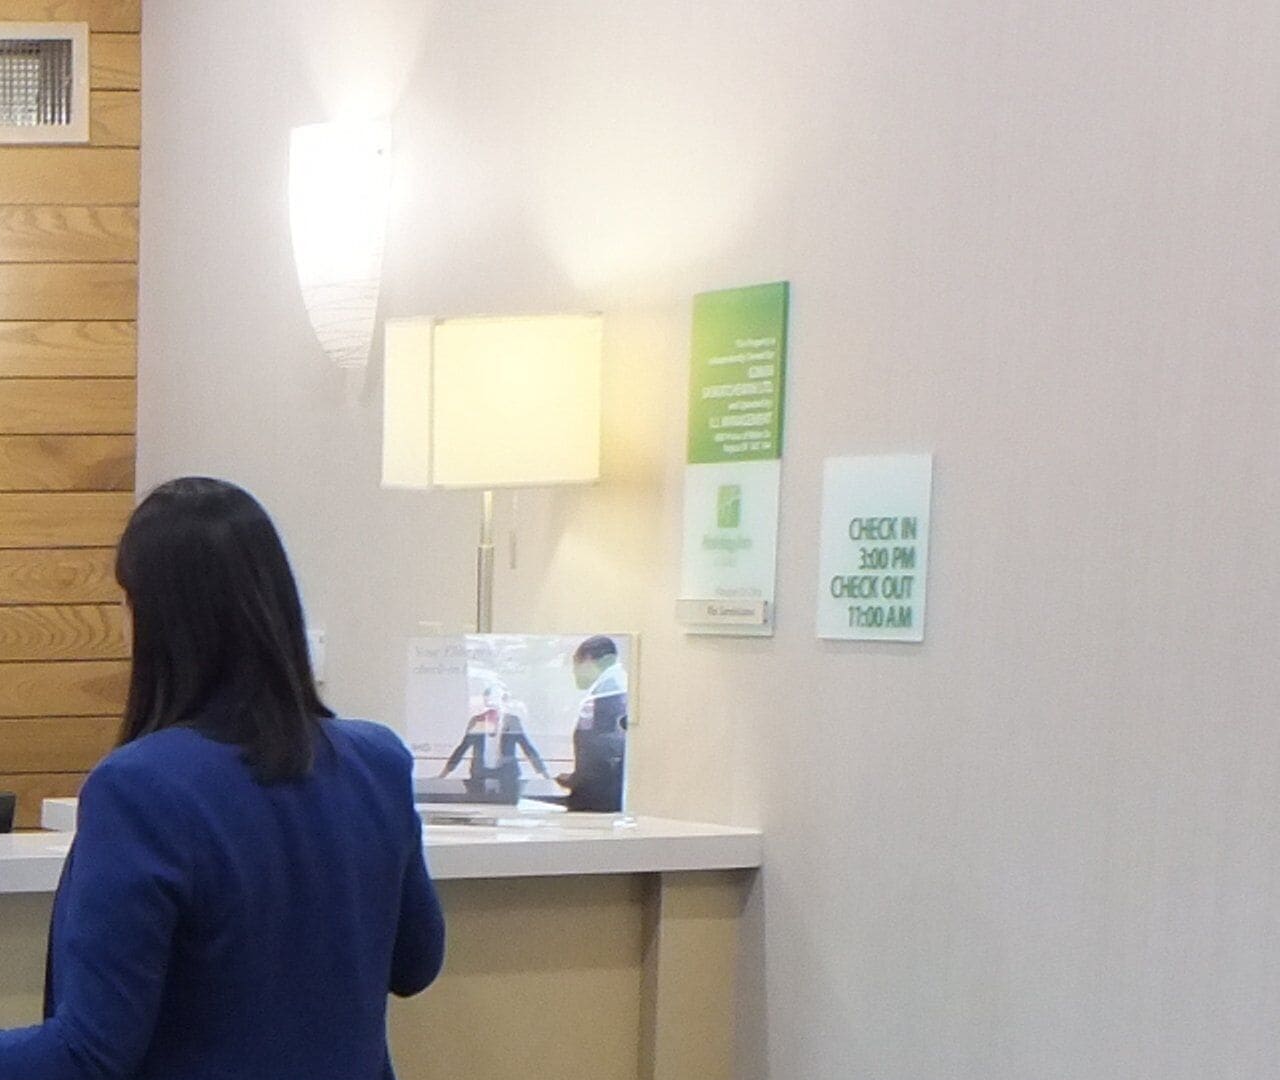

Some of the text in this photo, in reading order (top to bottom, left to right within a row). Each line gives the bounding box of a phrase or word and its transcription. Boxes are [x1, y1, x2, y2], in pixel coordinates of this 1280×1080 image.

[848, 517, 917, 540] CHECK IN
[858, 546, 915, 569] 3:00 PM
[831, 575, 914, 599] CHECK OUT
[848, 606, 884, 627] 11:00
